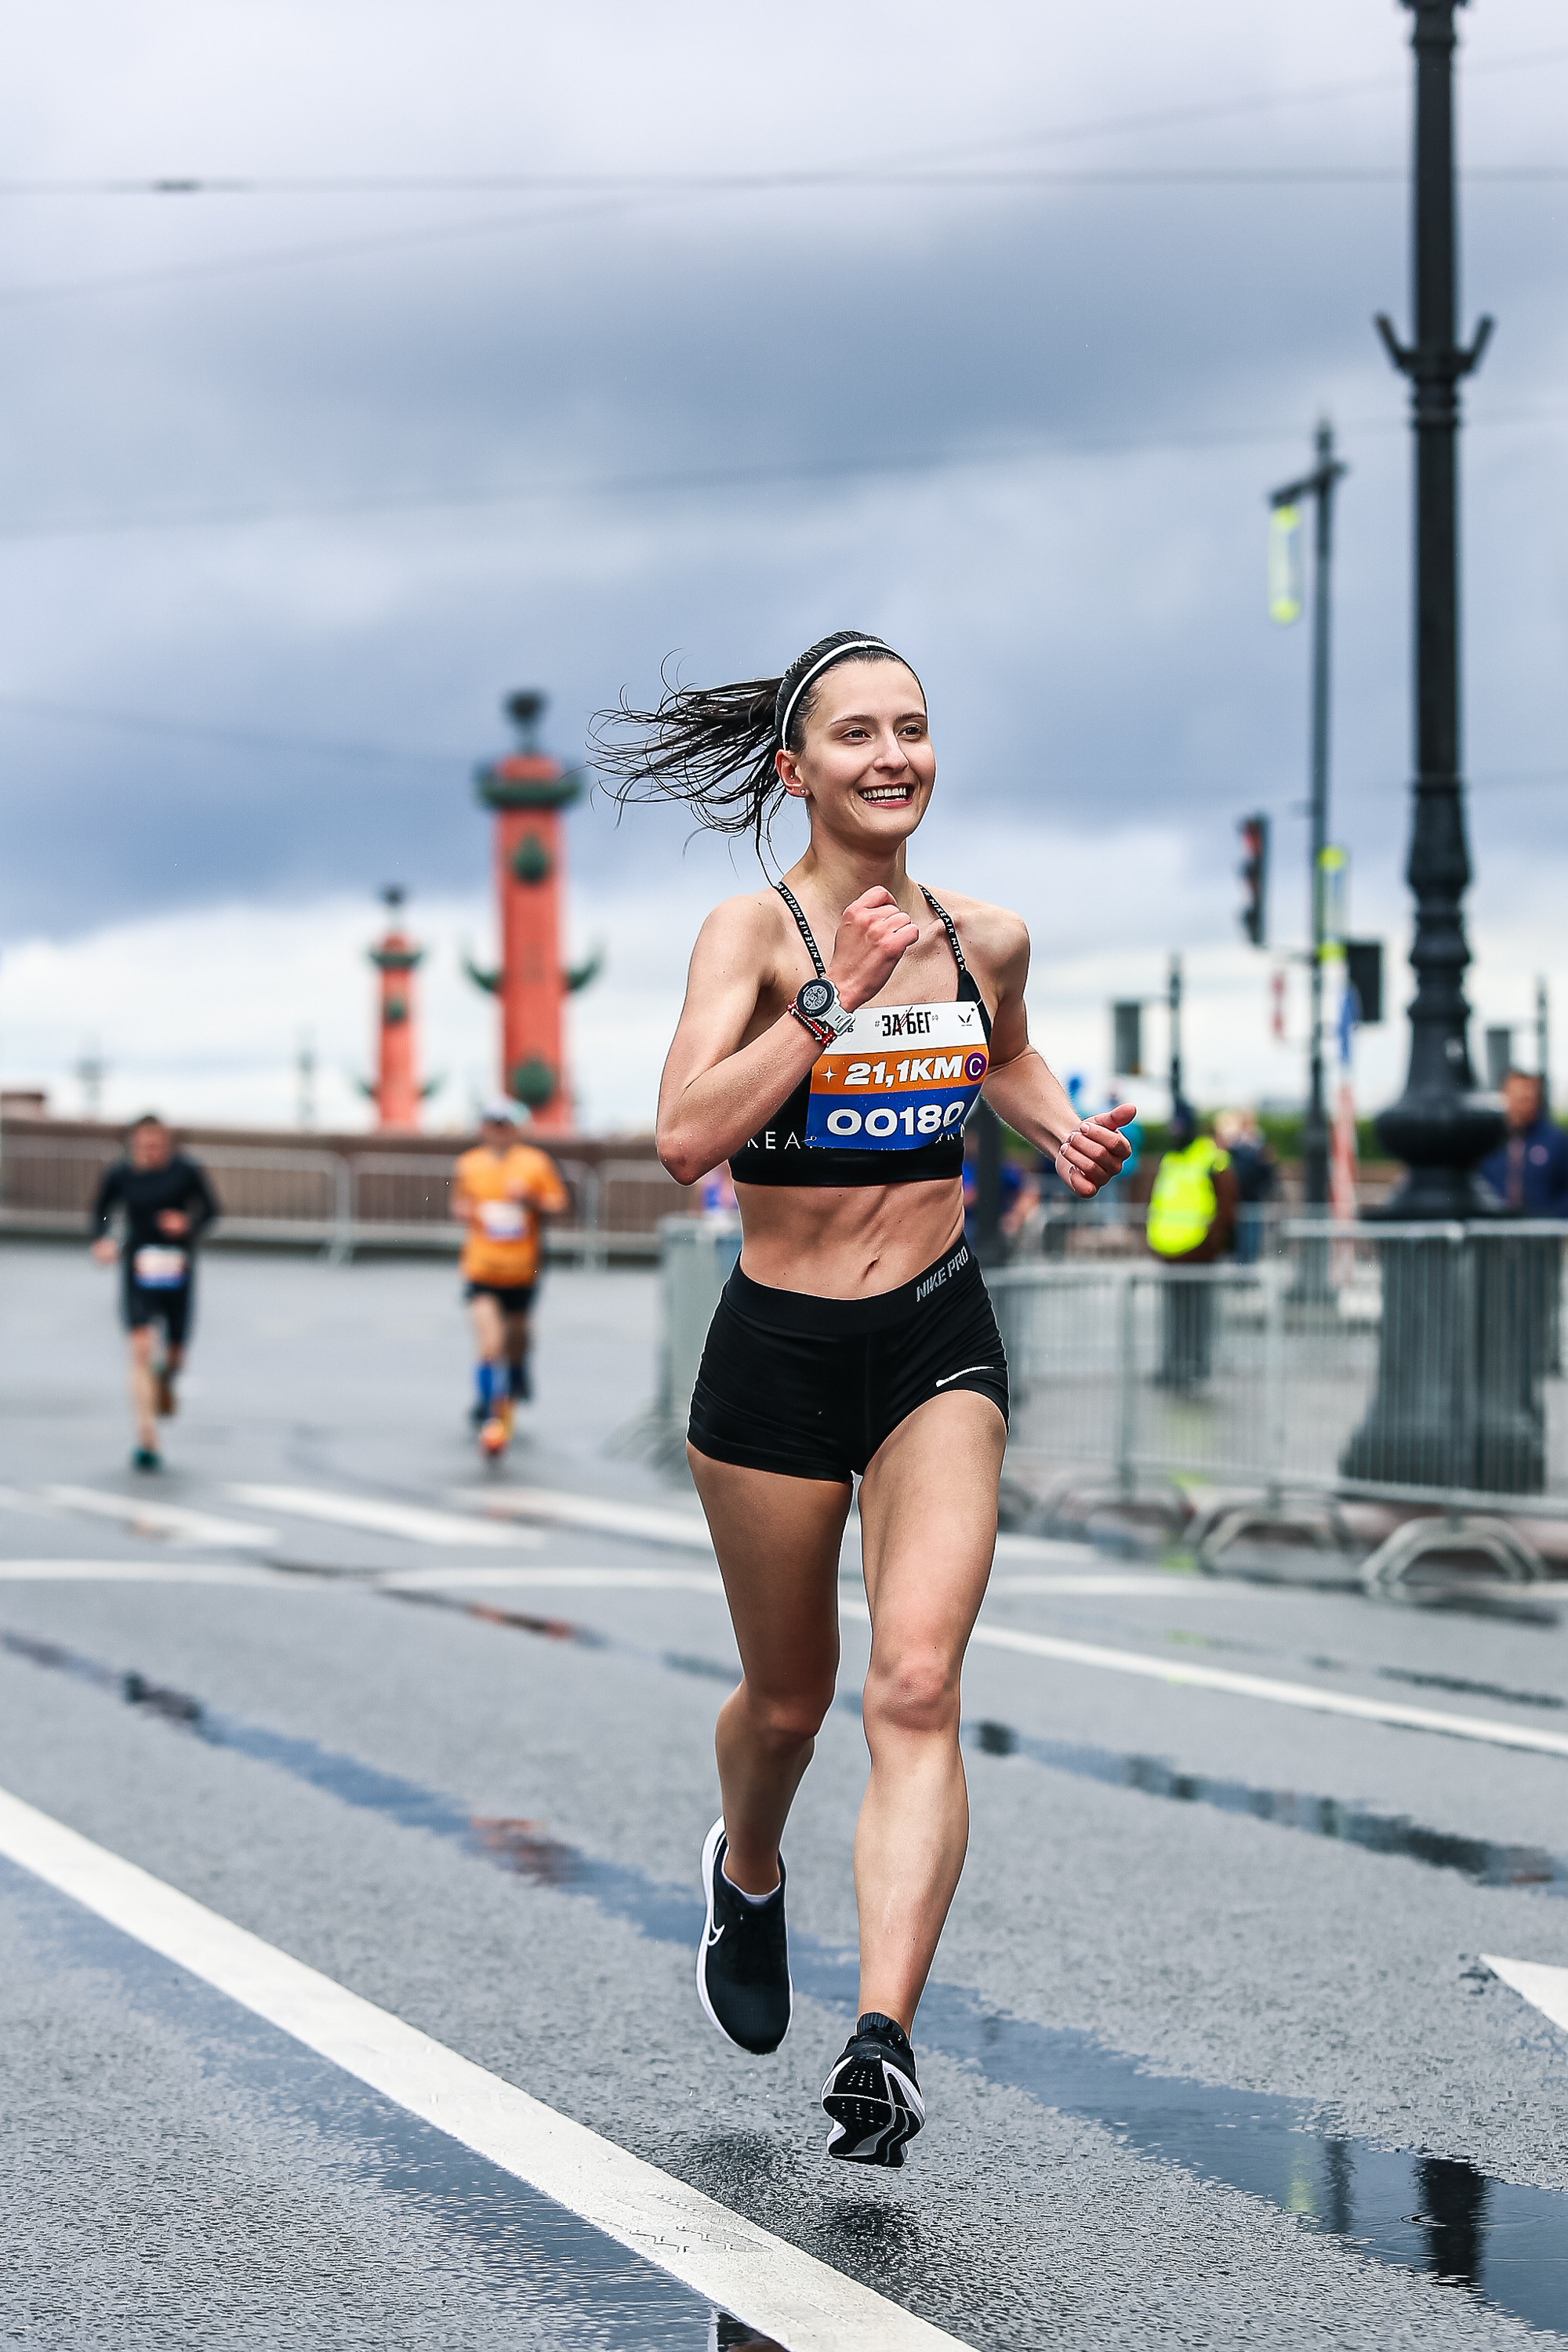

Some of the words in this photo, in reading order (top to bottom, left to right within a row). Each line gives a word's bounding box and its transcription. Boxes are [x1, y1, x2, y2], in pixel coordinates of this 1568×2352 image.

[826, 1101, 965, 1137] 00180
[916, 1266, 946, 1301] NIKE
[948, 1246, 968, 1278] PRO
